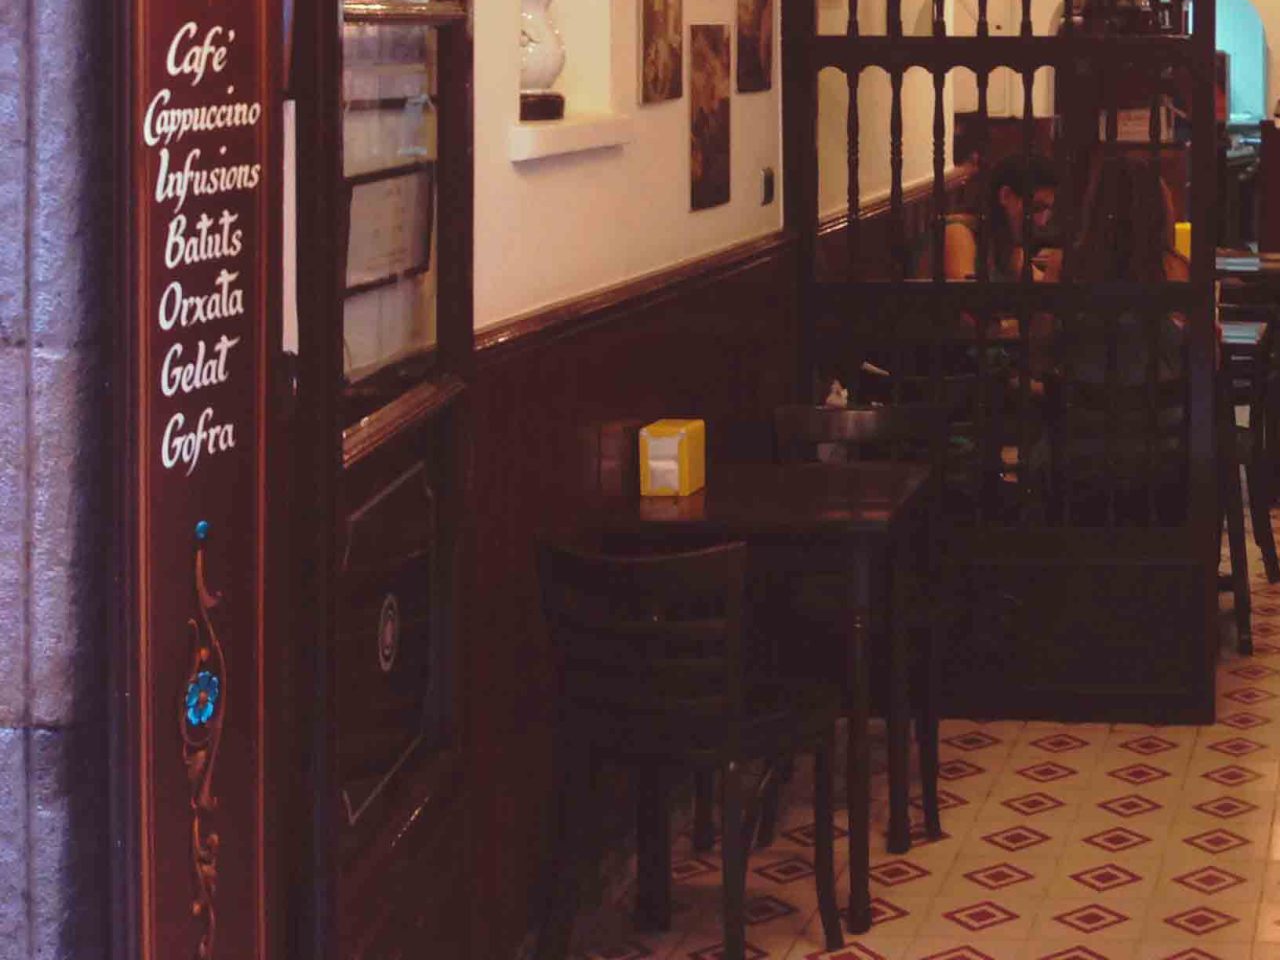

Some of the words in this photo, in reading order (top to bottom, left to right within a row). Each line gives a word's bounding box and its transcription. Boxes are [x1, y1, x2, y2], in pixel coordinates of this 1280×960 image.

[143, 85, 262, 147] Cappuccino
[155, 145, 262, 214] Infusions
[164, 209, 243, 269] Batuts
[158, 268, 245, 331] Orxata
[160, 334, 241, 398] Gelat
[161, 406, 236, 477] Gofra
